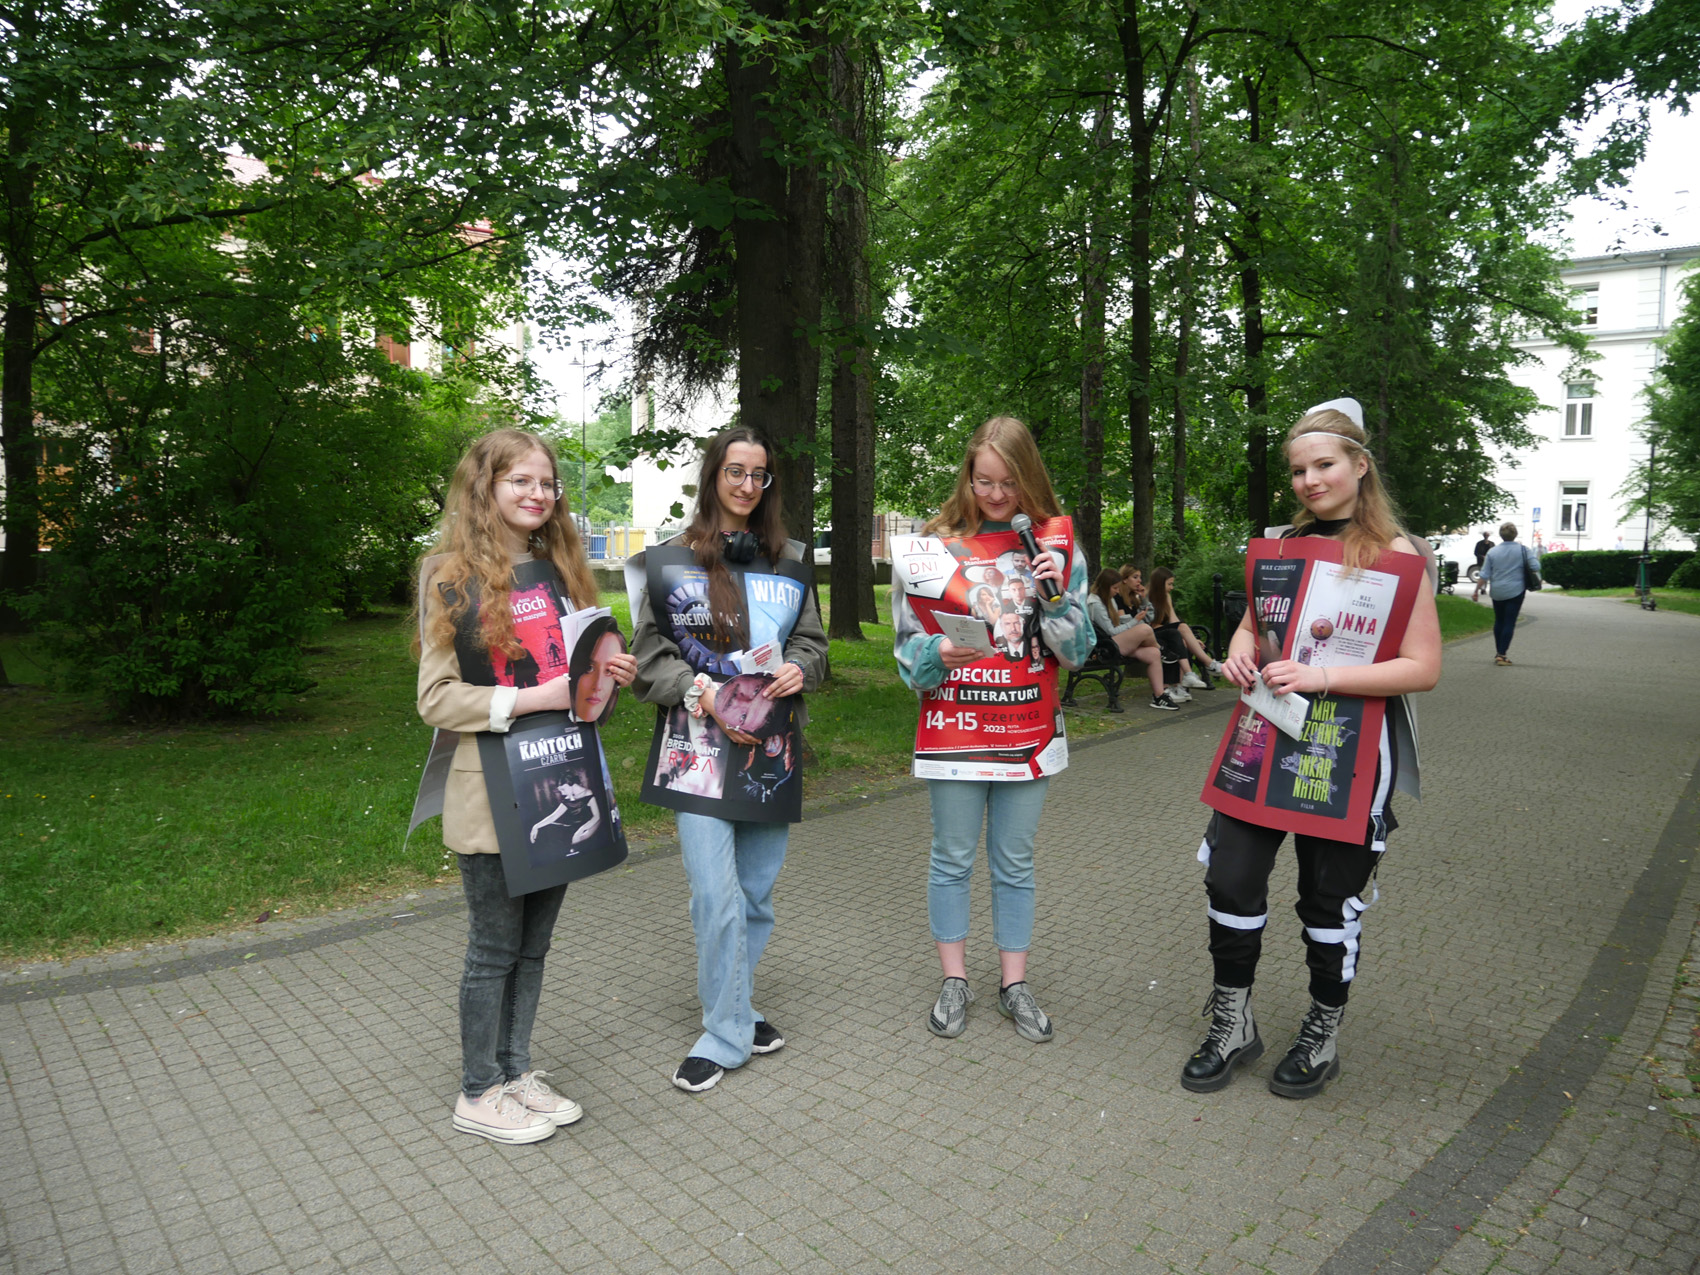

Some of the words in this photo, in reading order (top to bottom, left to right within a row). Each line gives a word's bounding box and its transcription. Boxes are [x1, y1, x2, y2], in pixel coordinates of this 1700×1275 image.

[909, 561, 938, 575] DNI
[751, 579, 801, 612] WIATR
[1359, 594, 1372, 602] MAX
[1335, 611, 1378, 635] INNA
[944, 667, 1012, 684] DECKIE
[930, 687, 955, 701] DNI
[959, 687, 1039, 702] LITERATURY
[926, 710, 979, 731] 14-15
[981, 710, 1041, 722] czerwca
[1311, 699, 1337, 723] MAX
[983, 724, 1006, 733] 2023
[519, 732, 583, 761] KAŃTOCH
[540, 752, 568, 766] CZARNE
[668, 750, 713, 775] RYSA
